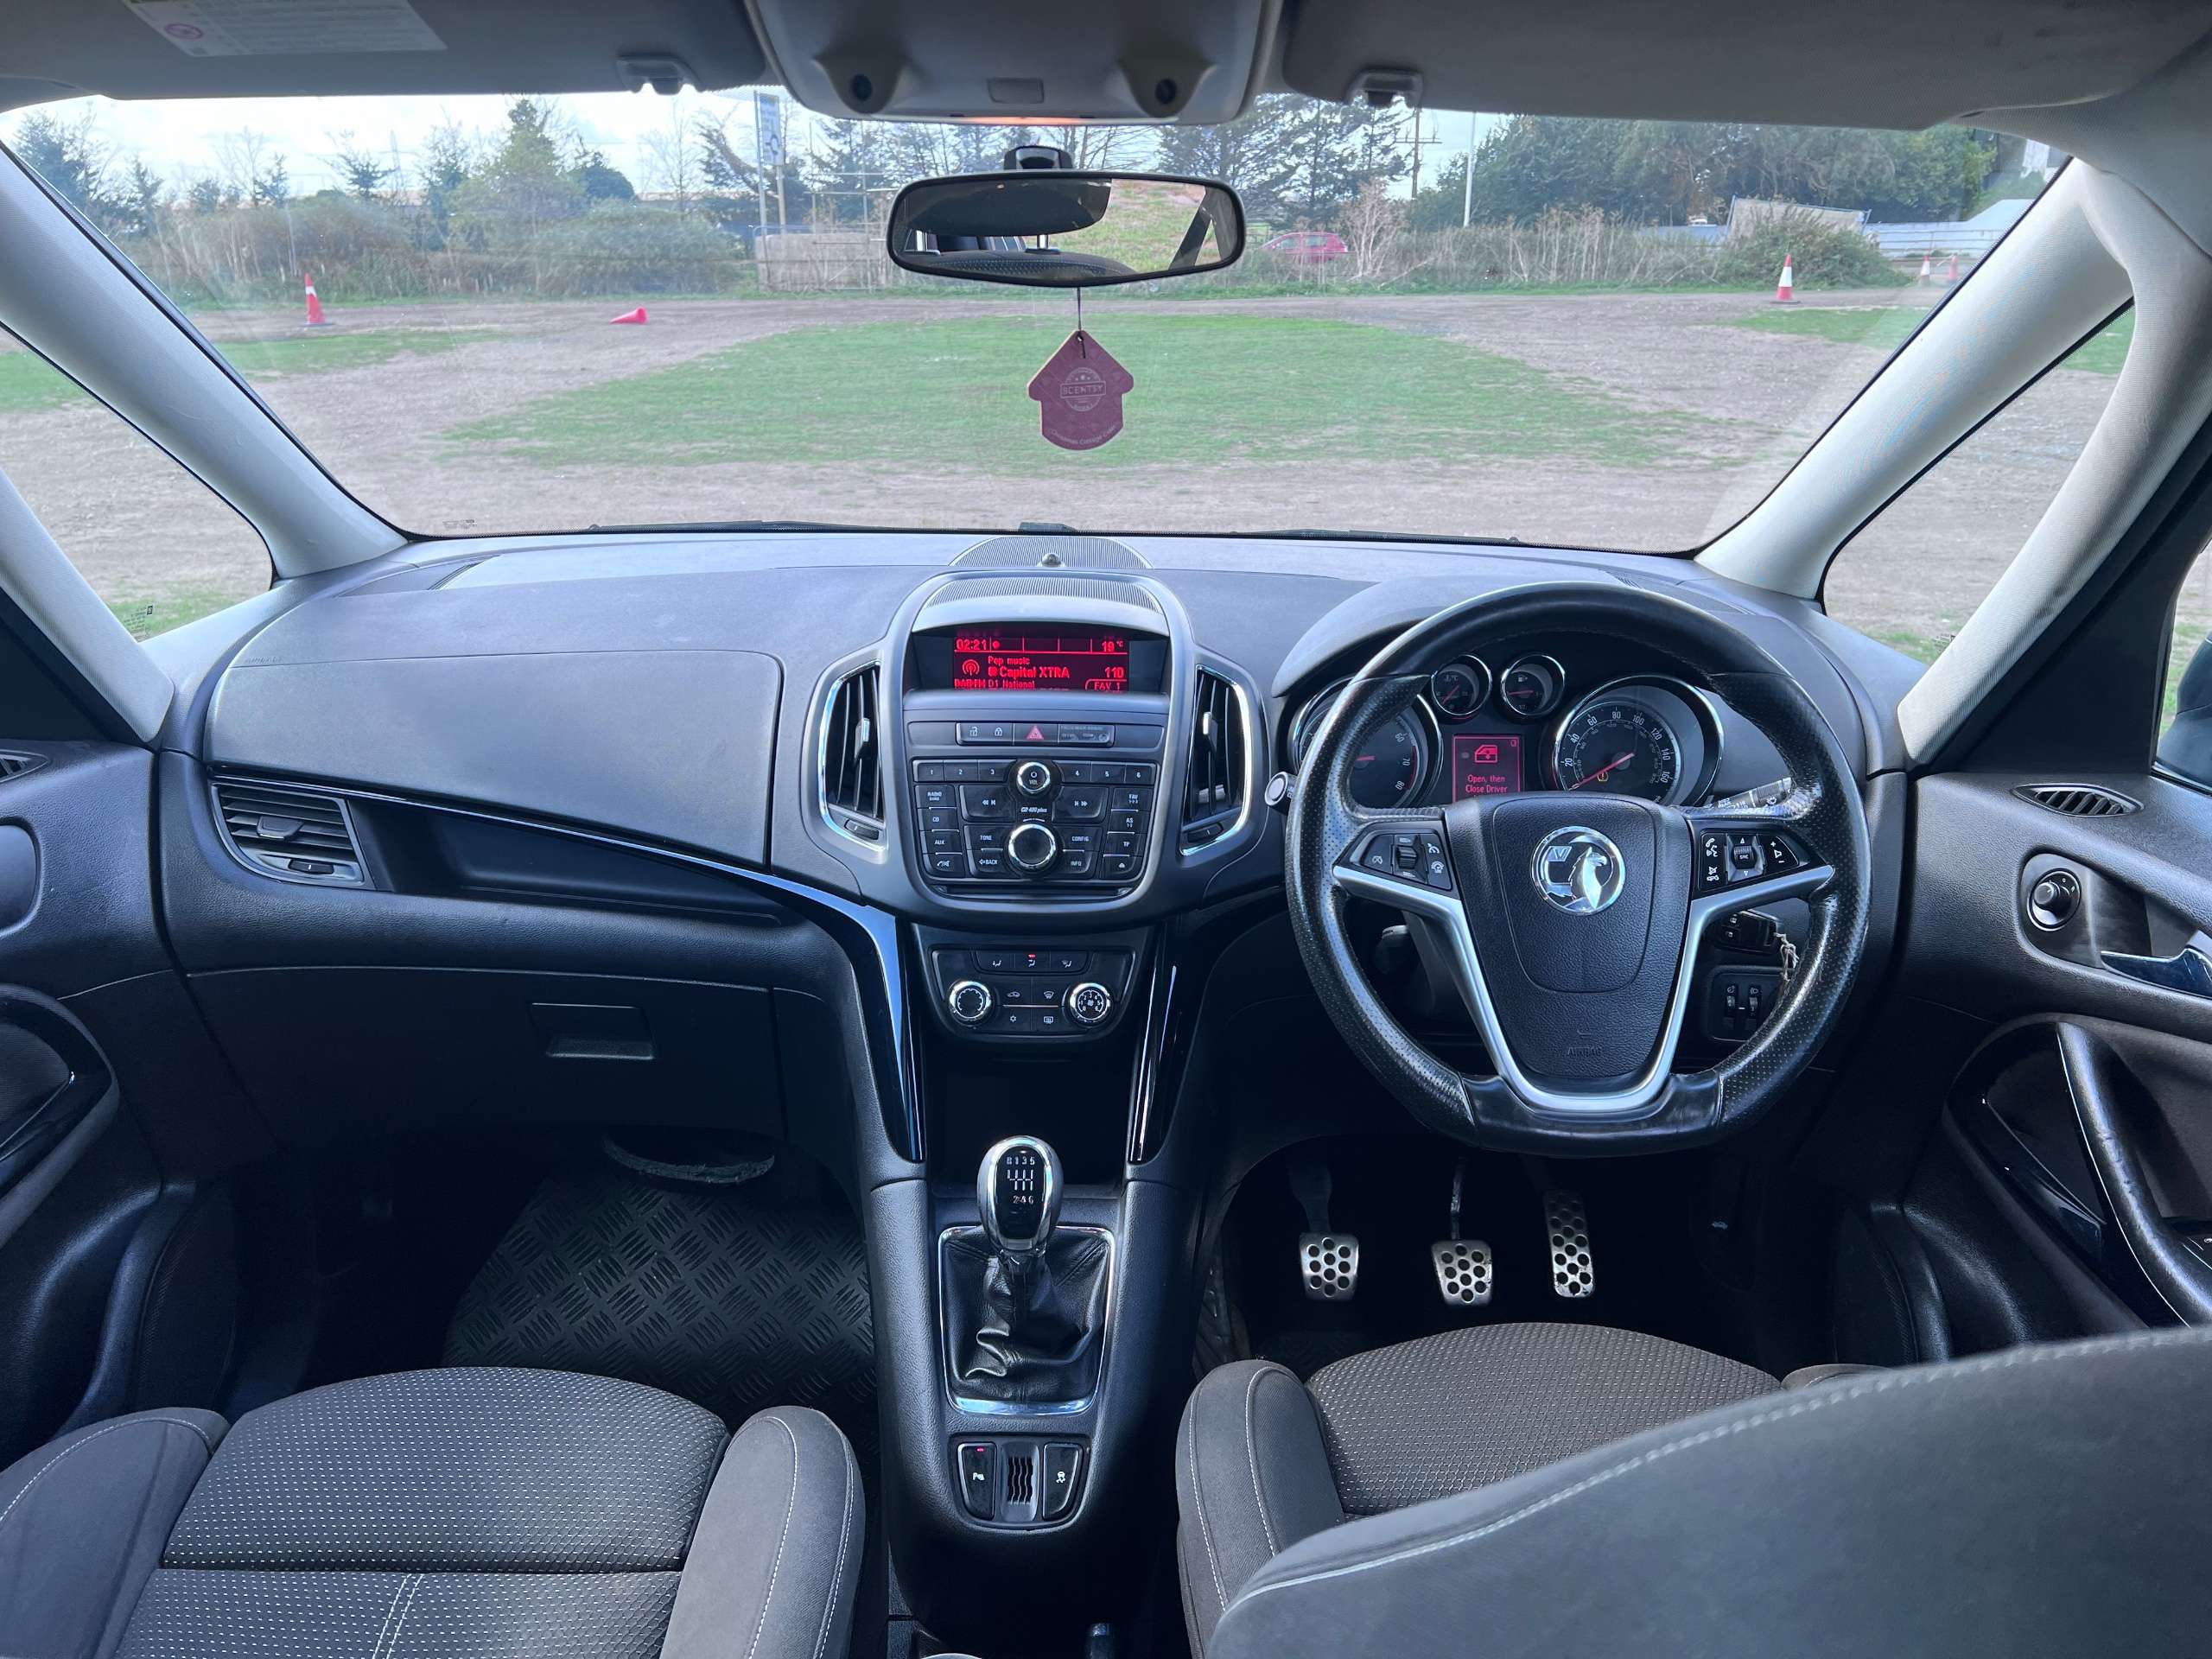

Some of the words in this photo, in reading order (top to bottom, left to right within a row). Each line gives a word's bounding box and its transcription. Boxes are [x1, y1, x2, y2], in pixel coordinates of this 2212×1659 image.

[957, 639, 987, 651] 02:21
[988, 656, 1003, 666] Pop
[1000, 666, 1037, 680] Capital
[1039, 666, 1070, 678] XTRA
[1002, 679, 1035, 689] National
[1094, 682, 1112, 690] FAV
[1586, 716, 1598, 726] 60
[1632, 715, 1645, 726] 100
[1395, 733, 1405, 742] 60
[1570, 733, 1580, 744] 40
[1650, 728, 1662, 741] 120
[1661, 748, 1671, 760] 140
[1402, 758, 1410, 766] 70
[1564, 758, 1573, 767] 20
[1660, 771, 1670, 784] 160
[1395, 780, 1405, 791] 80
[1465, 784, 1484, 793] Close
